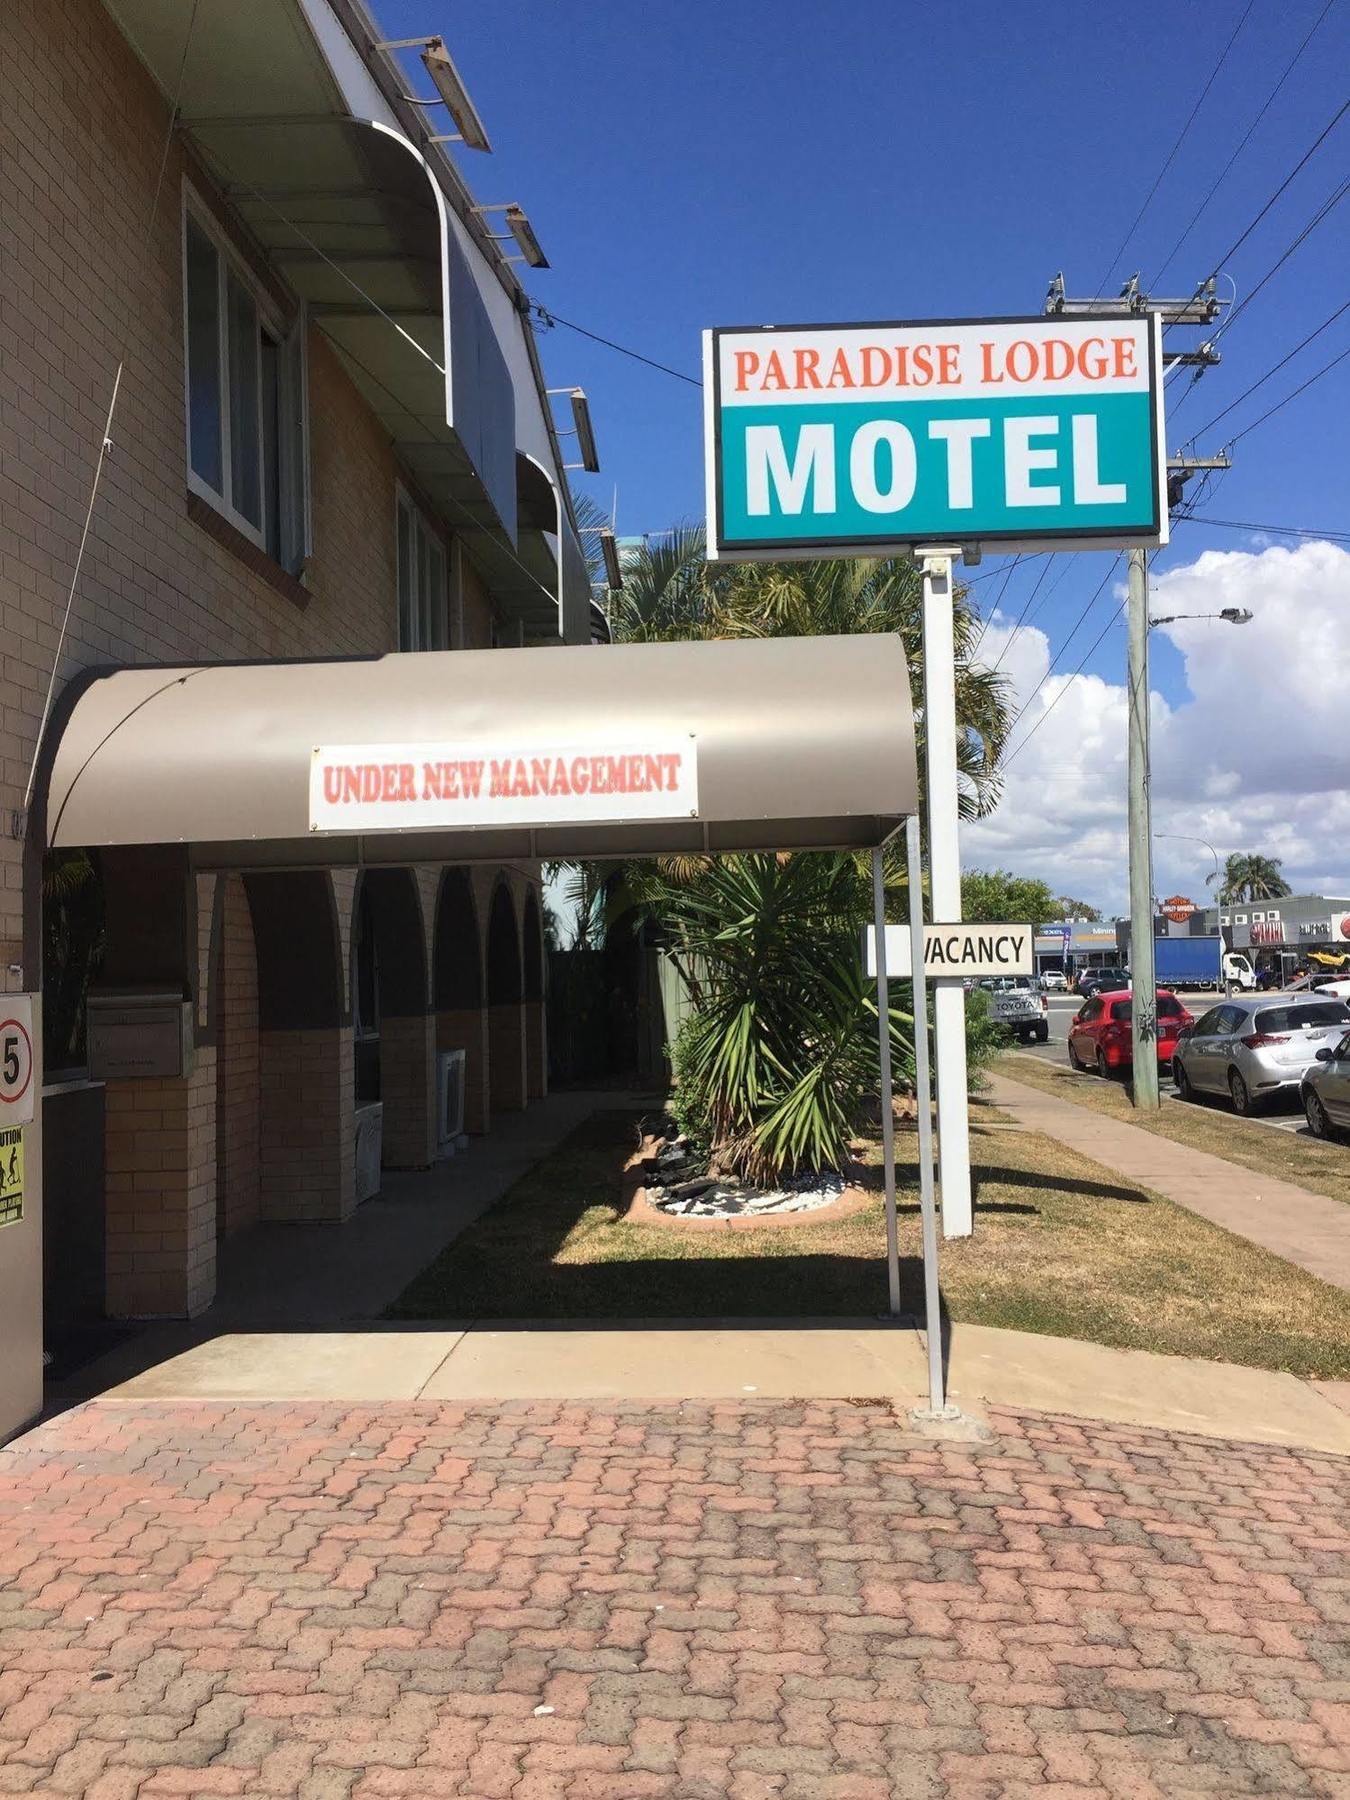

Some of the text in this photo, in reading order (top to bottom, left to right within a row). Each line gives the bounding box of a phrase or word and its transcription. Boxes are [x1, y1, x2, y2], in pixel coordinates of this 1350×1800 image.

[734, 337, 1138, 392] PARADISE LODGE
[745, 413, 1127, 516] MOTEL
[323, 753, 683, 804] UNDER NEW MANAGEMENT
[996, 1001, 1035, 1011] TOYOTA
[3, 1037, 21, 1086] 5
